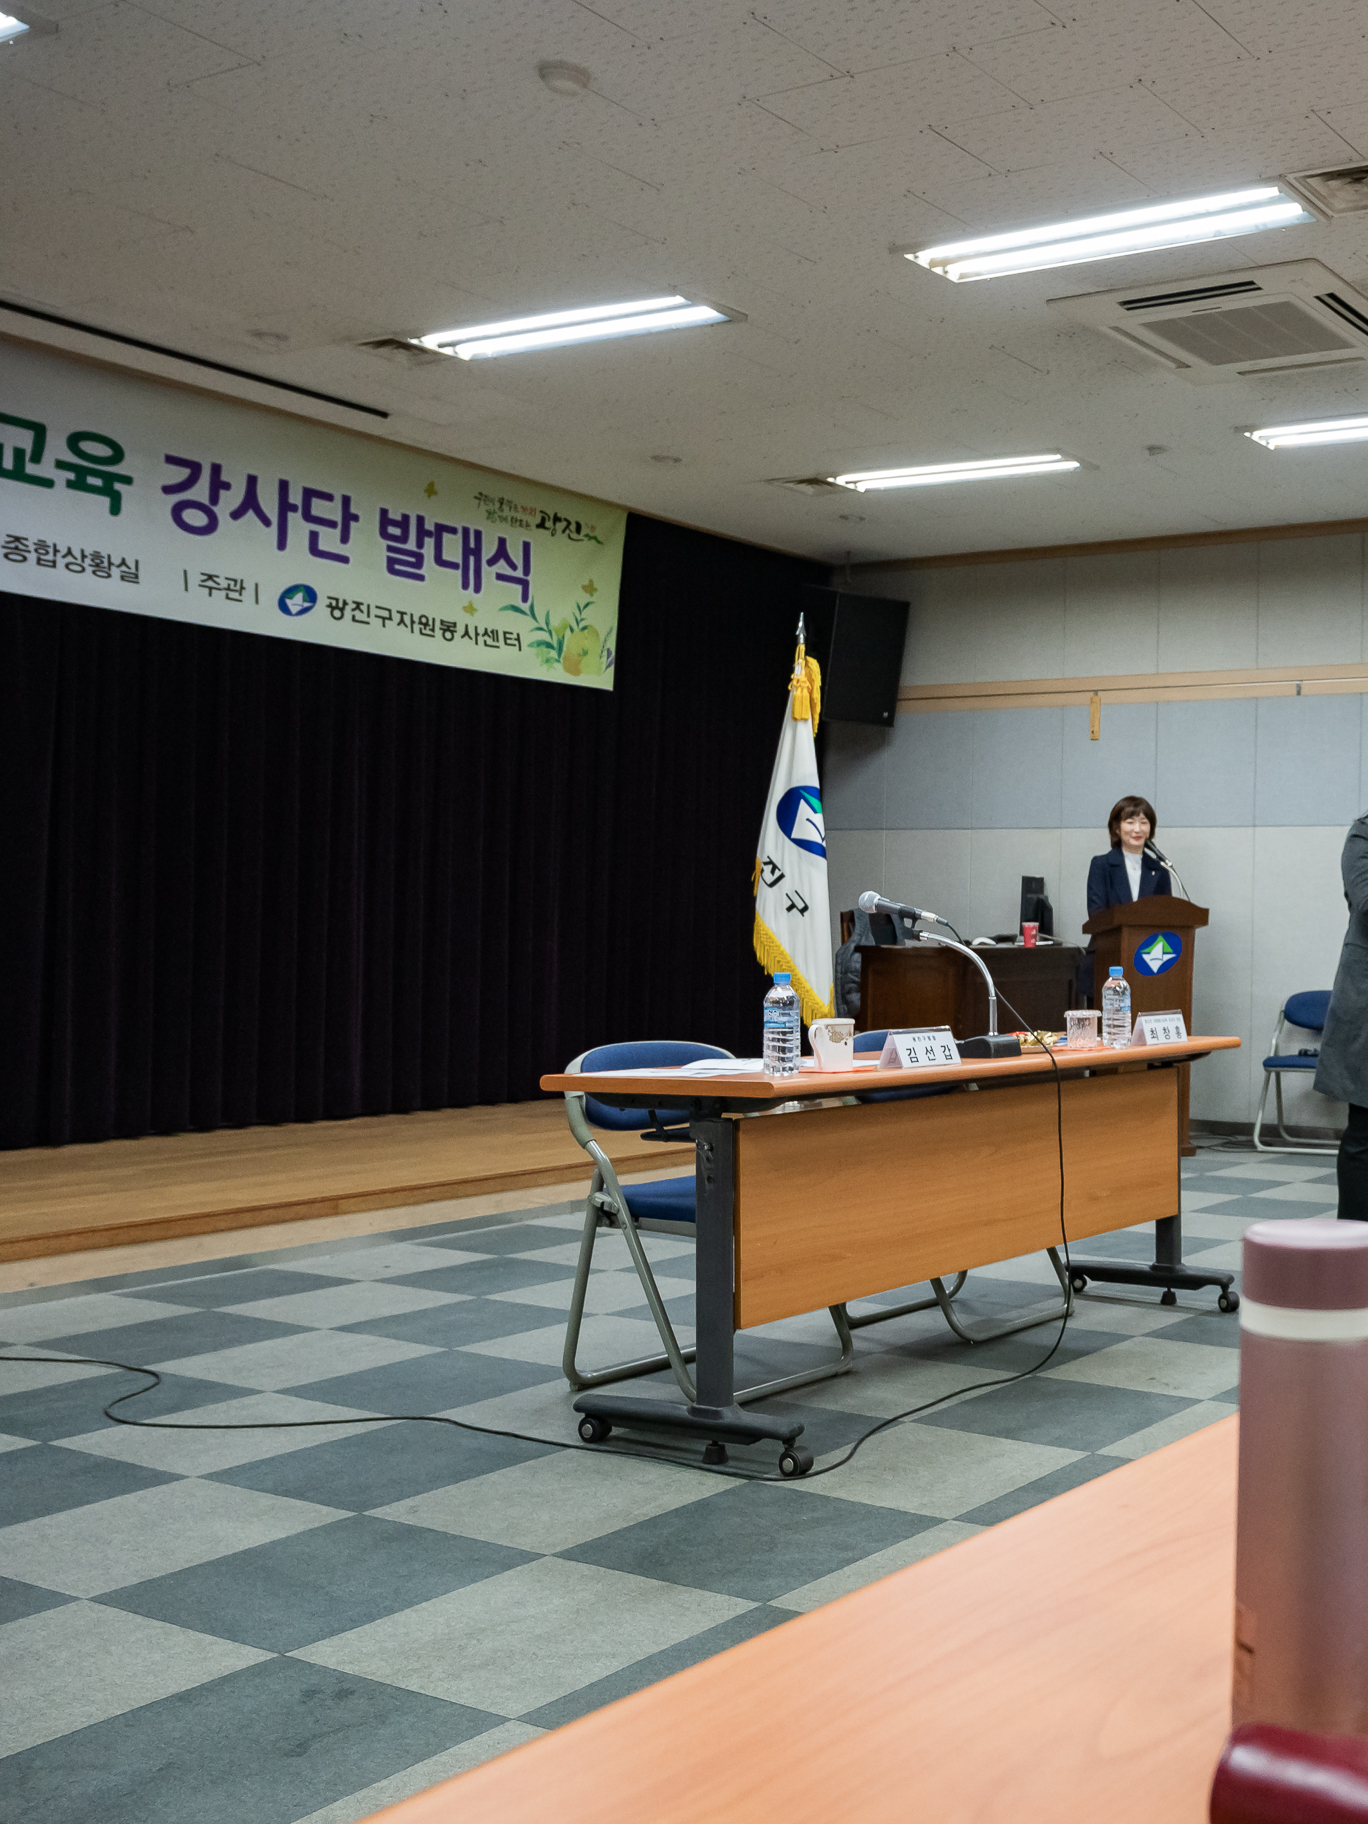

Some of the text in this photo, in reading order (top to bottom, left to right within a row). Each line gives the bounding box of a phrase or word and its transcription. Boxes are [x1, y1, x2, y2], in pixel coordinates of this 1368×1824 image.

[0, 413, 532, 604] 교육 강사단 발대식
[535, 510, 584, 541] 광진
[1, 533, 140, 584] 종합상황실
[325, 595, 522, 651] 광진구자원봉사센터
